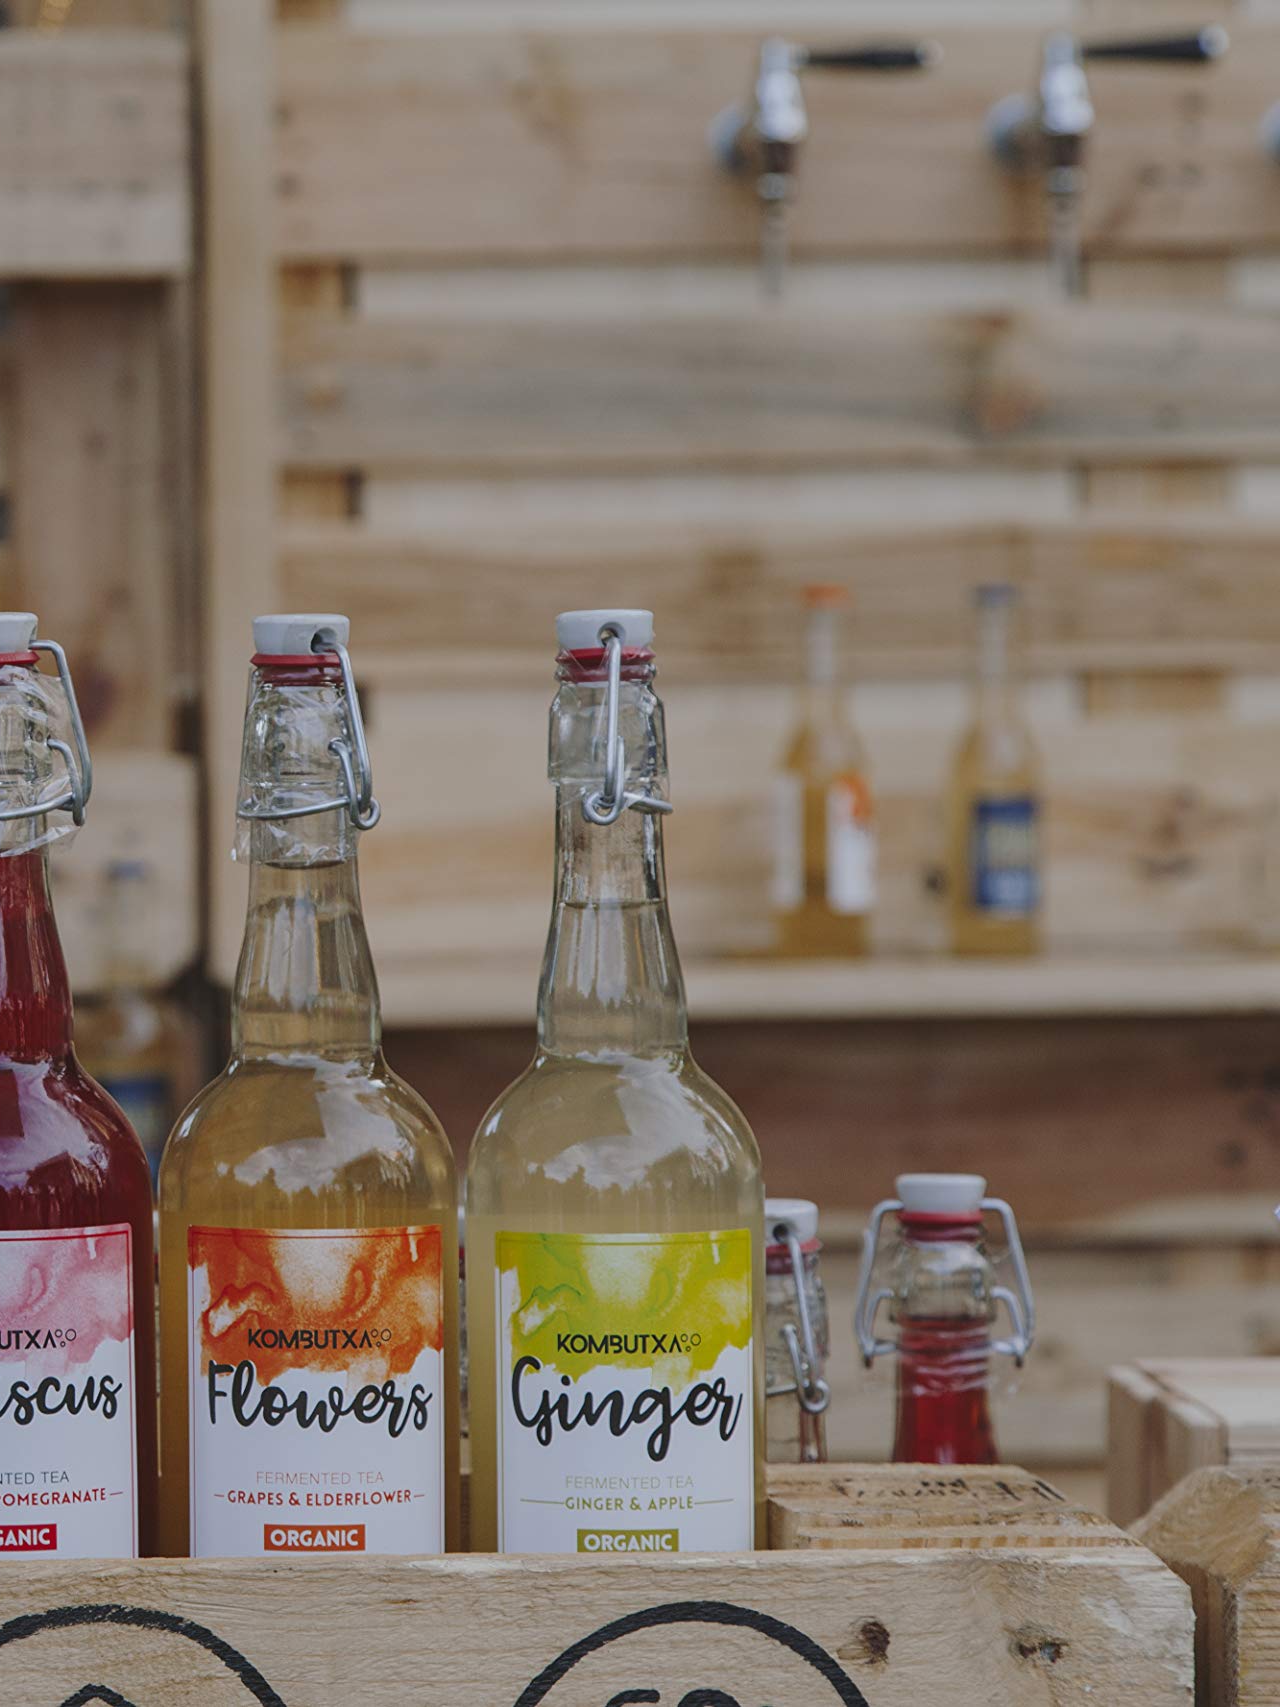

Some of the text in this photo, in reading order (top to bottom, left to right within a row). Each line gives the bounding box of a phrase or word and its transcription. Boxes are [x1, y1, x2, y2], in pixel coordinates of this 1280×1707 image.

[247, 1328, 372, 1349] KOMBUTXA
[556, 1332, 681, 1355] KOMBUTXA
[208, 1360, 433, 1438] Flowers
[511, 1355, 743, 1463] Ginger
[40, 1470, 71, 1485] TEA
[256, 1471, 385, 1486] FERMENTED TEA
[565, 1475, 695, 1490] FERMENTED TEA
[227, 1489, 412, 1507] GRAPES & ELDERFLOWER
[564, 1496, 694, 1511] GINGER & APPLE
[270, 1528, 359, 1548] ORGANIC
[583, 1533, 673, 1551] ORGANIC
